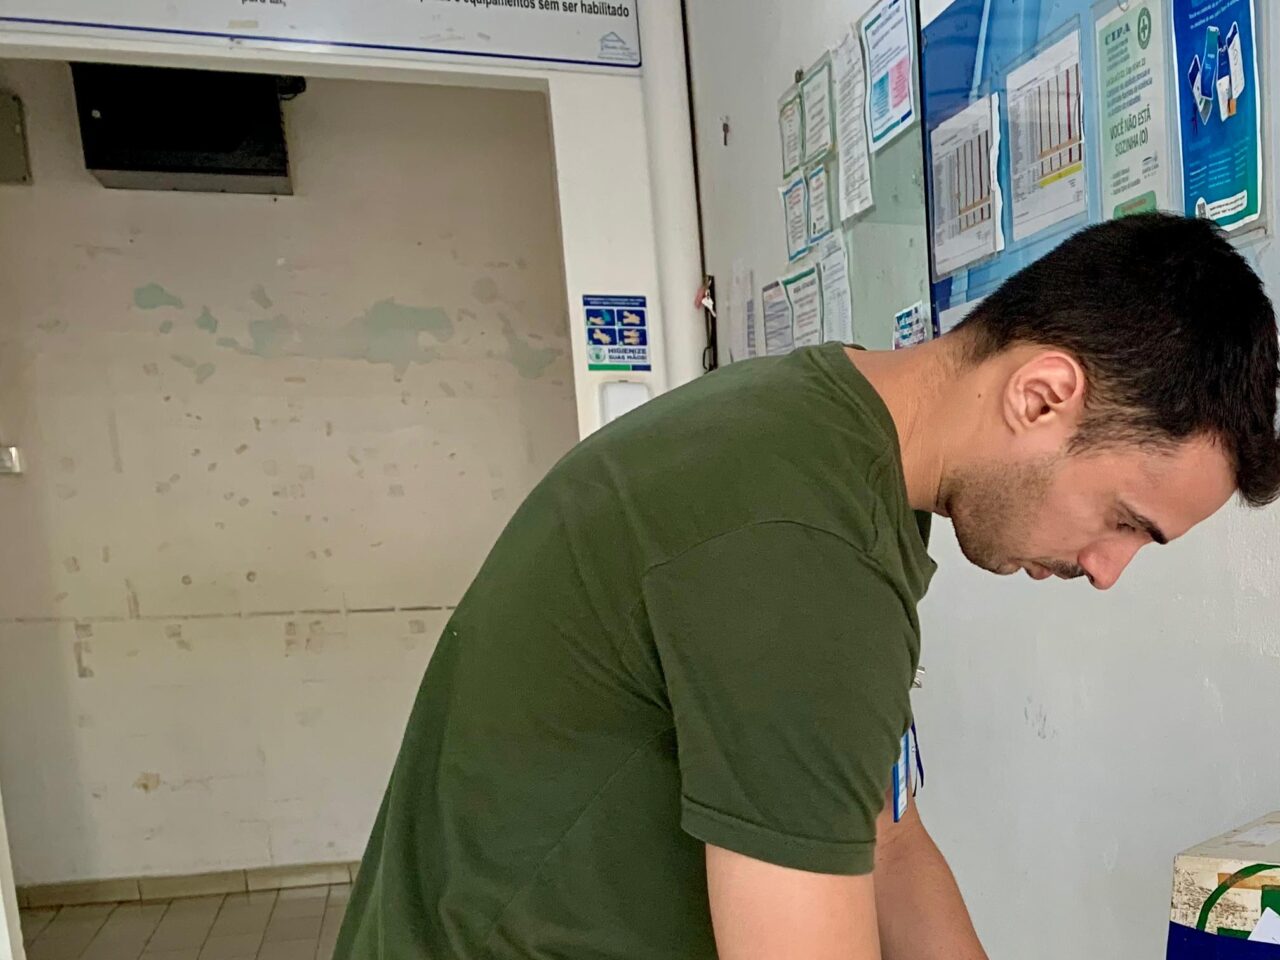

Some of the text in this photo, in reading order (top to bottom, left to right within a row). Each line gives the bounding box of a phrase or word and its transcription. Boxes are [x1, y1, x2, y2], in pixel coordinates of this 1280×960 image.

[562, 2, 578, 13] ser
[580, 1, 630, 17] habilitado
[1105, 23, 1131, 46] CIPA
[1124, 113, 1138, 132] NÃO
